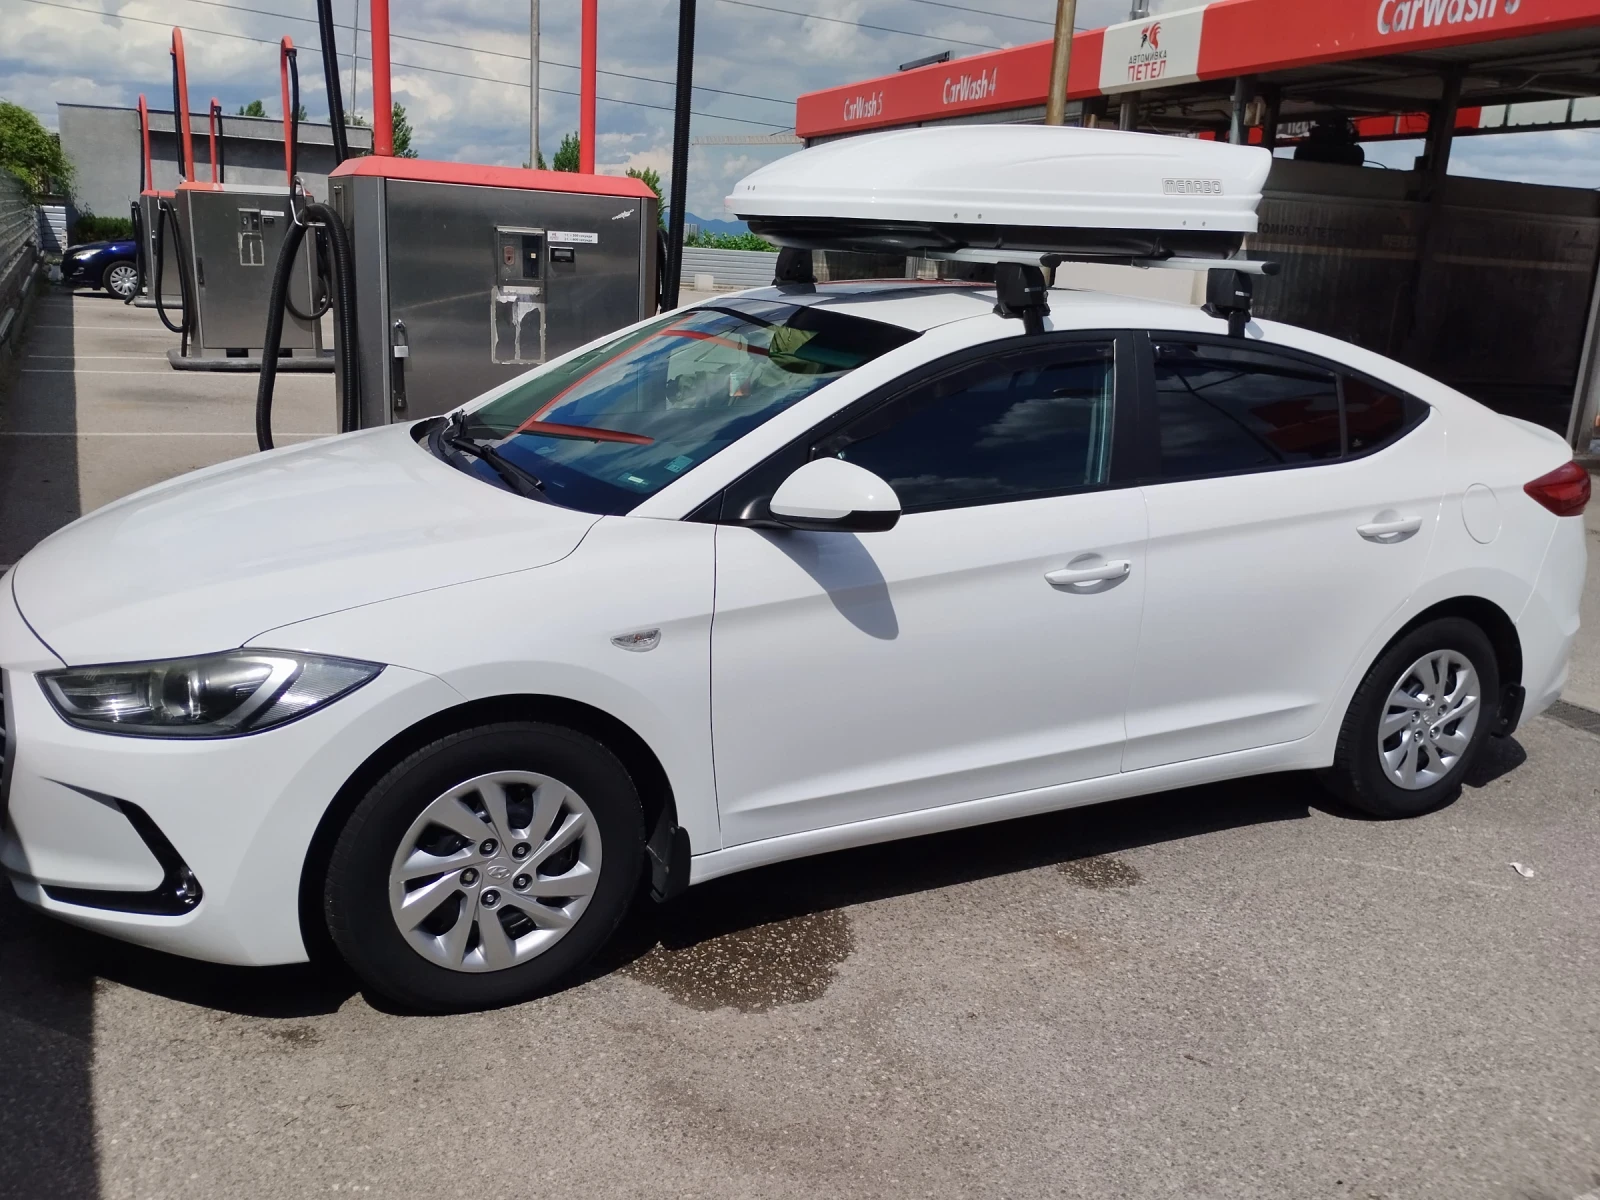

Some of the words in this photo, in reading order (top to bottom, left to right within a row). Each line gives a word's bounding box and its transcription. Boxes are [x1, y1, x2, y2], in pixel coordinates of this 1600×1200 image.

[1128, 50, 1167, 64] АВТОМИВКА
[1127, 60, 1167, 82] ПЕТЕЛ
[943, 69, 988, 104] CarWash
[988, 67, 998, 97] 4
[843, 91, 877, 121] CarWash
[876, 91, 884, 116] 5
